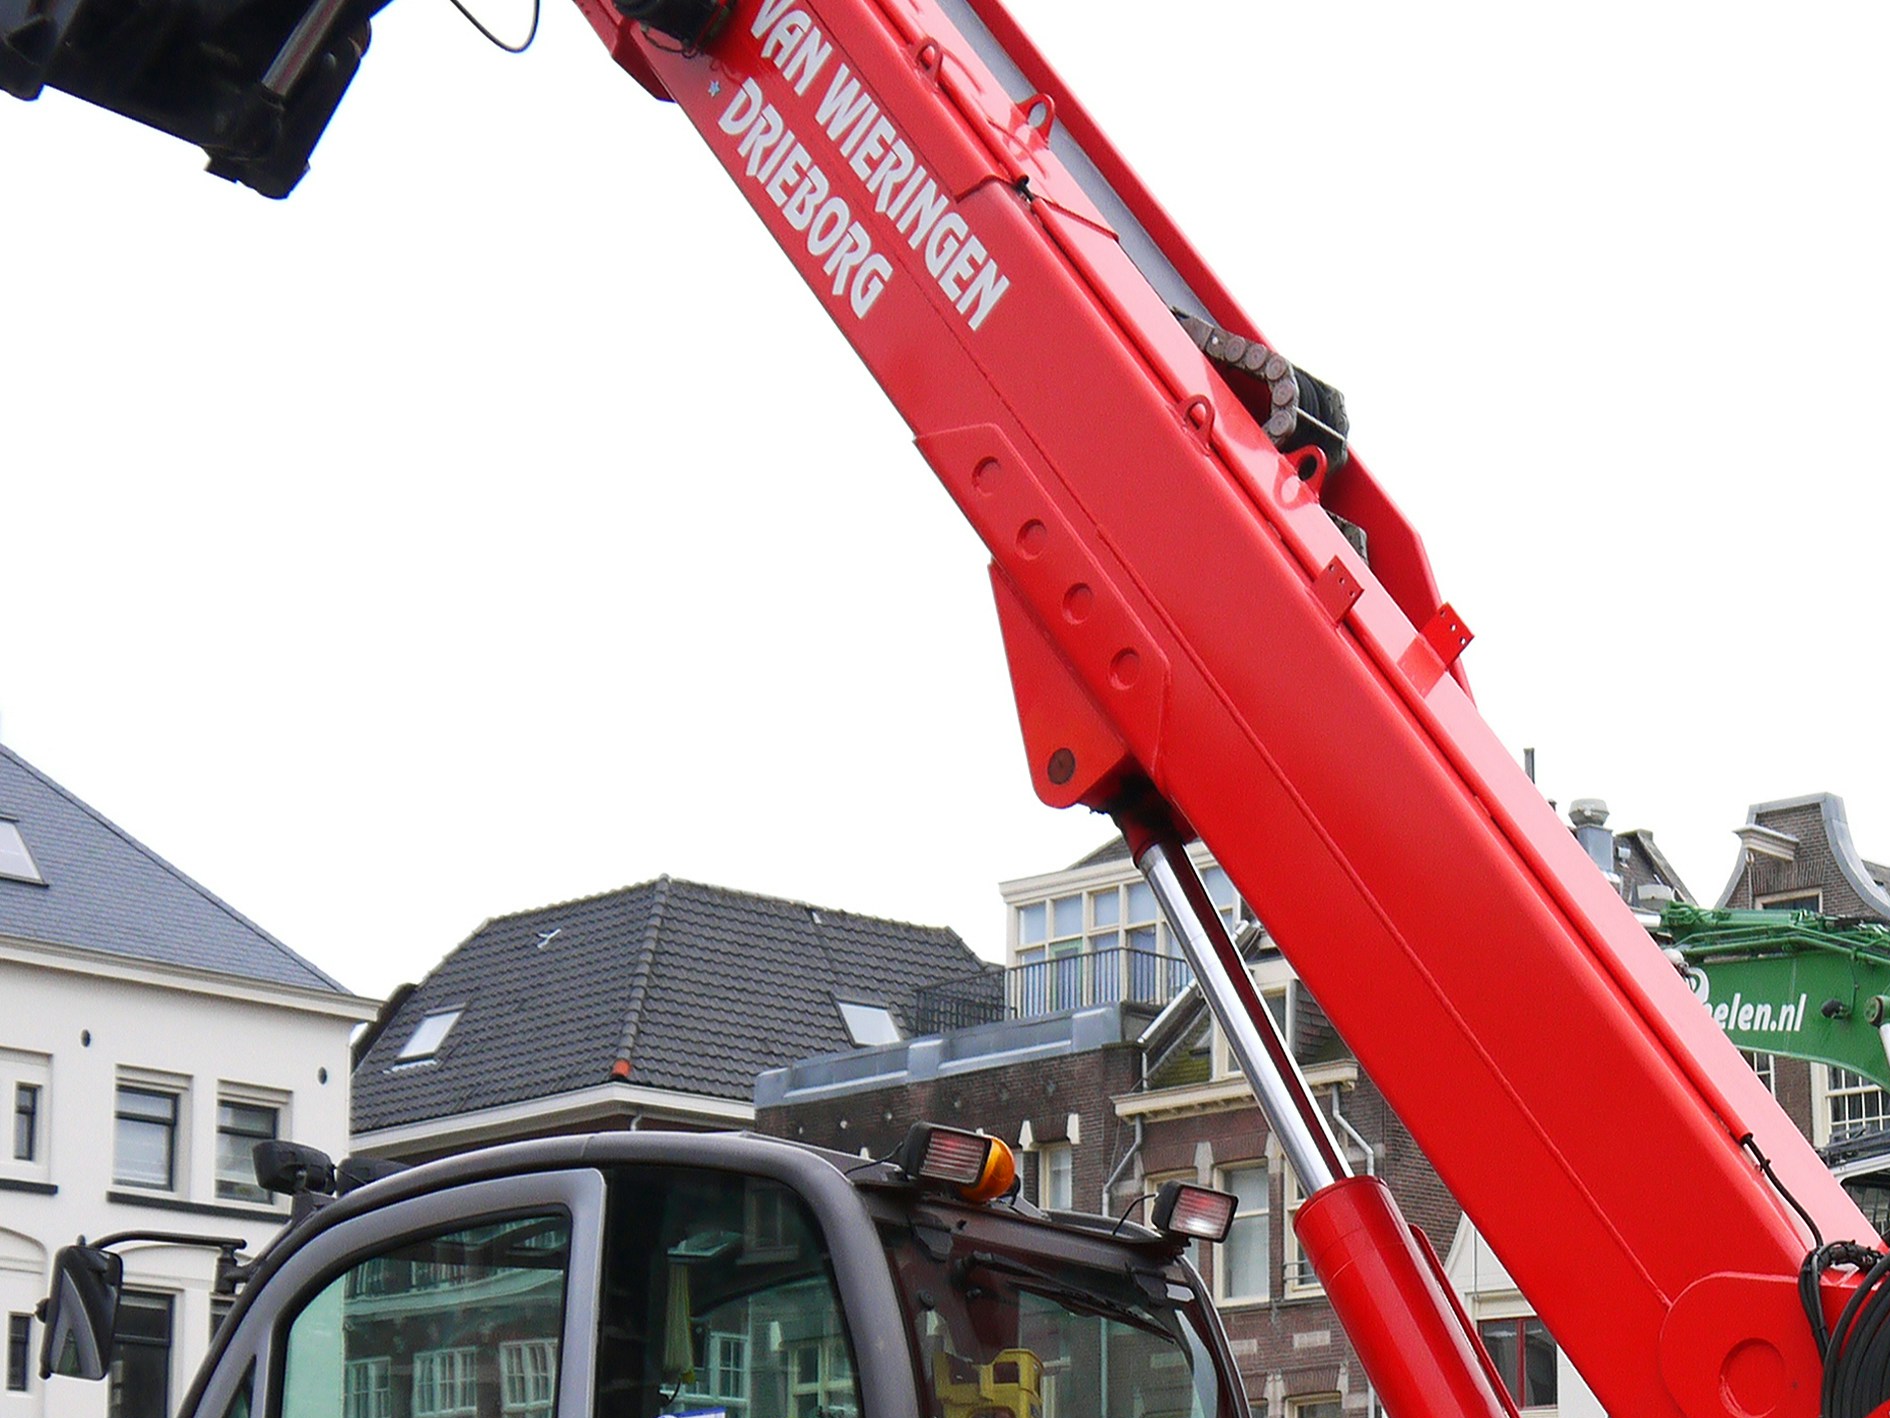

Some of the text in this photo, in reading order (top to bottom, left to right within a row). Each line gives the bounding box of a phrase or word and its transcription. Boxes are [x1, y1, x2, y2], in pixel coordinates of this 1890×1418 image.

[717, 76, 893, 319] DRIEBORG
[750, 0, 1010, 331] VAN WIERINGEN
[1687, 967, 1808, 1032] elen.nl
